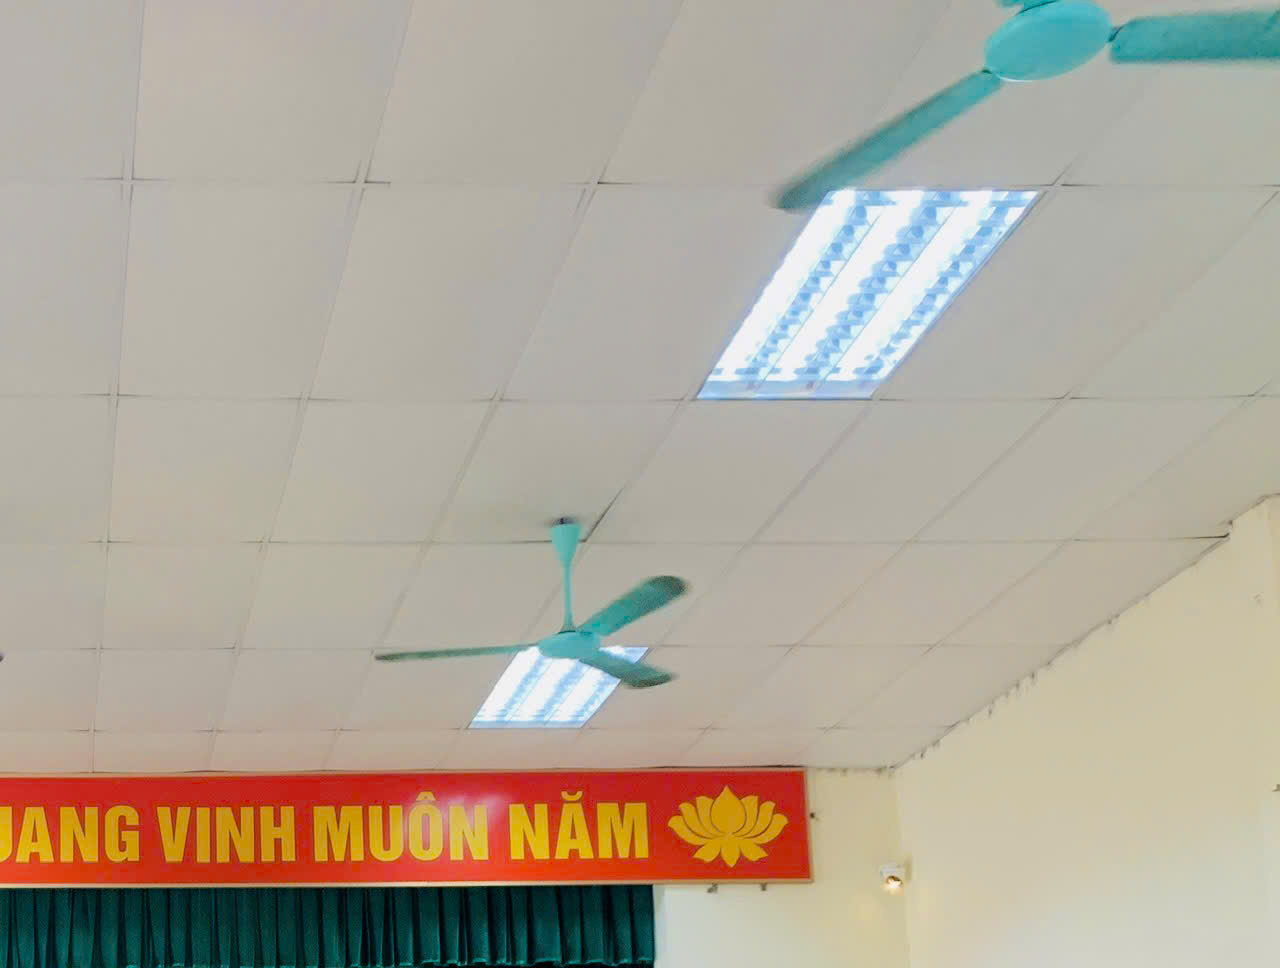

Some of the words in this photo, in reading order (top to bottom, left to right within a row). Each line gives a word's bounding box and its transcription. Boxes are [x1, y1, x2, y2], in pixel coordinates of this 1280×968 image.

[157, 806, 296, 864] VINH
[313, 791, 489, 861] MUÔN
[509, 791, 649, 860] NĂM
